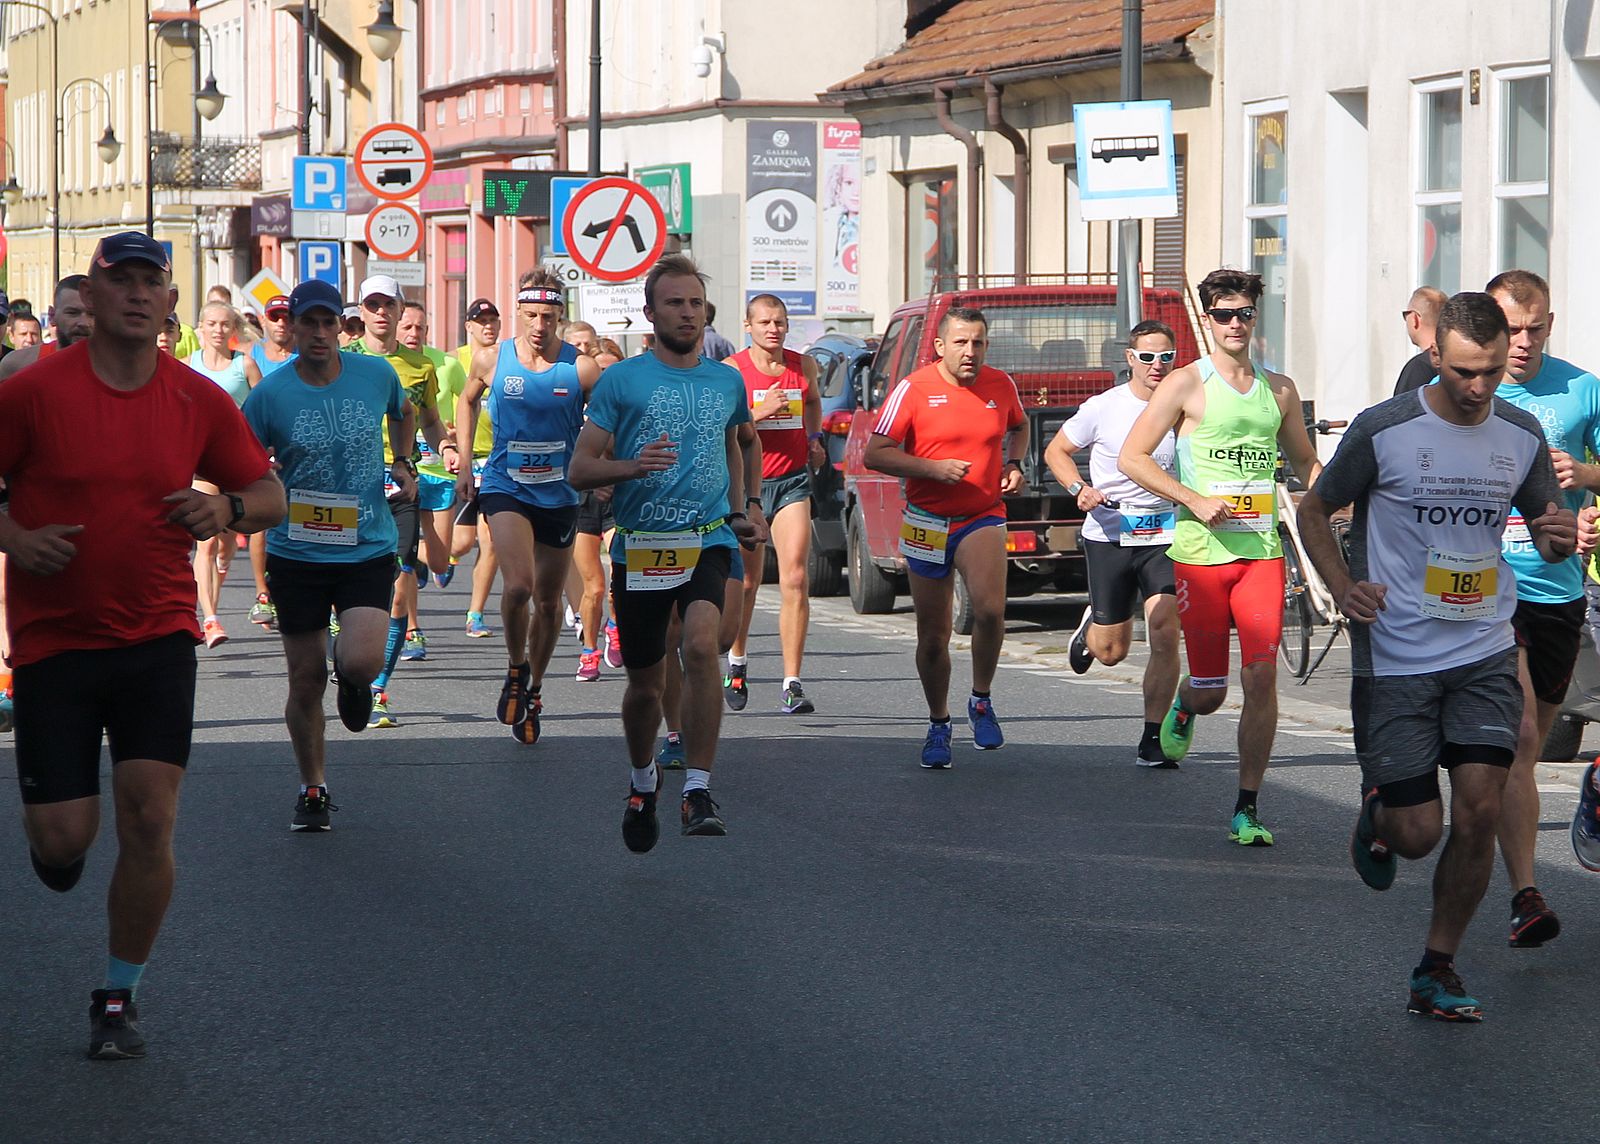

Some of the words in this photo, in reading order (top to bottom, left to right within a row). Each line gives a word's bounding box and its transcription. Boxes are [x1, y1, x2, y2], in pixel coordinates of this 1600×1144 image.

[752, 154, 811, 168] ZAMKOWA
[305, 162, 336, 204] P
[256, 224, 287, 232] PLAY
[379, 224, 410, 237] 9-17
[752, 237, 770, 246] 500
[772, 236, 809, 246] metrów
[308, 246, 332, 278] P
[827, 281, 846, 291] 500
[610, 297, 629, 306] Bieg
[593, 306, 642, 315] Przemysław
[522, 454, 551, 467] 322
[1209, 449, 1237, 460] ICE
[1244, 461, 1275, 469] TEAM
[1232, 496, 1253, 510] 79
[313, 506, 333, 522] 51
[1135, 515, 1161, 528] 246
[912, 527, 926, 542] 13
[651, 550, 677, 567] 73
[1450, 573, 1482, 593] 182
